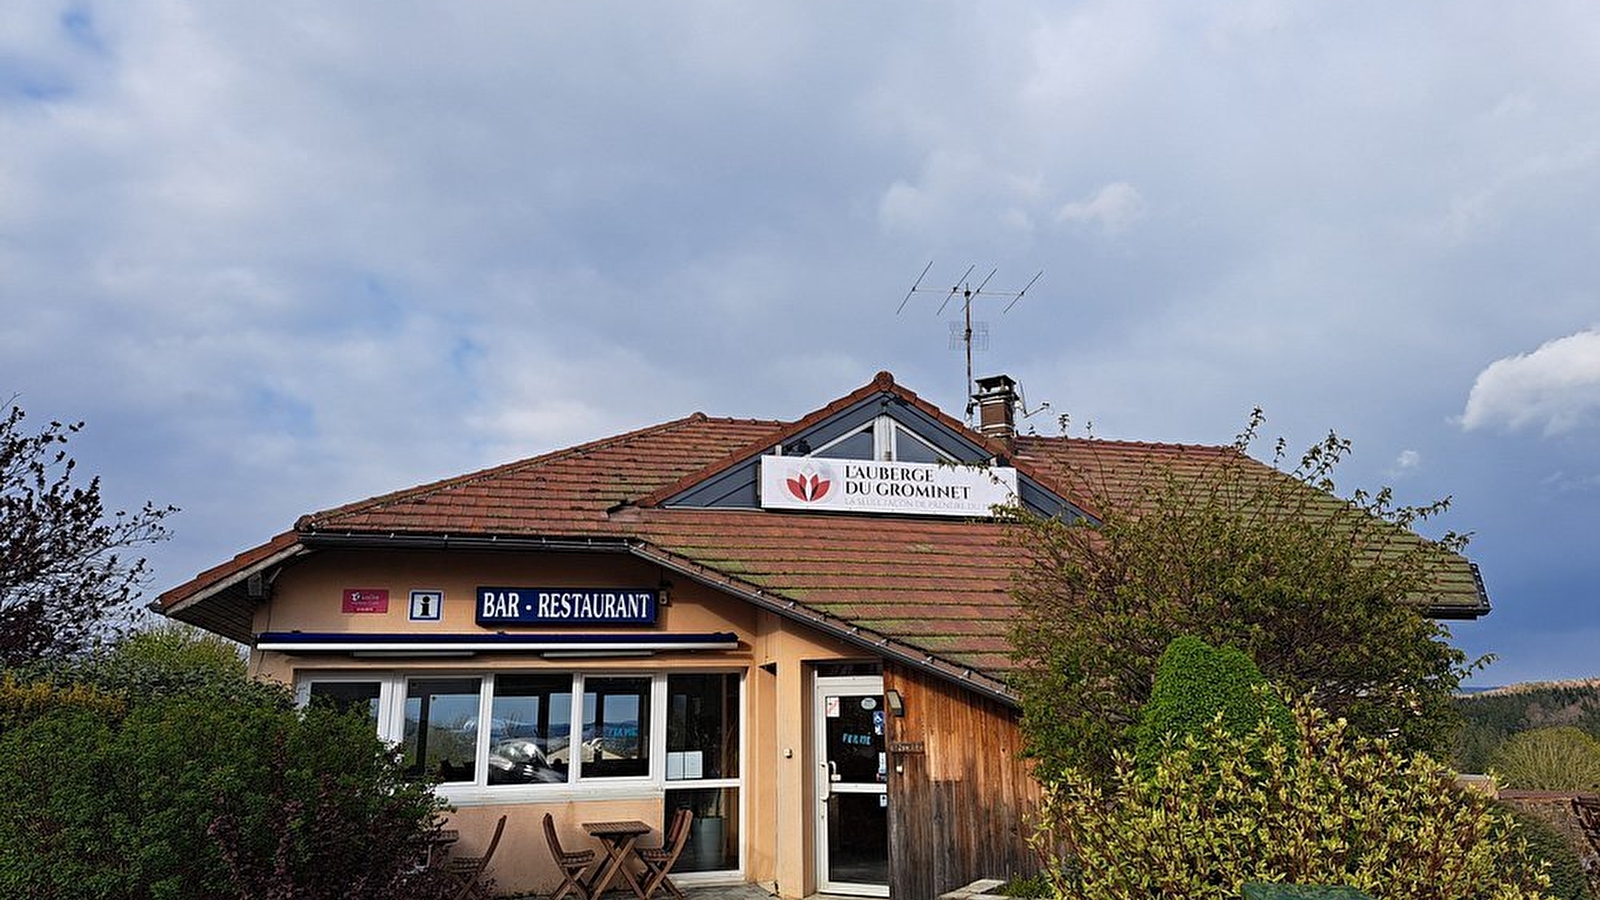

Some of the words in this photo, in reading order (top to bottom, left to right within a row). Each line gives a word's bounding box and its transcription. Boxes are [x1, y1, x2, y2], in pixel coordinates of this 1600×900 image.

[846, 465, 934, 482] L'AUBERGE
[846, 481, 871, 495] DU
[876, 483, 970, 500] GROMINET
[482, 592, 520, 618] BAR
[536, 592, 650, 618] RESTAURANT
